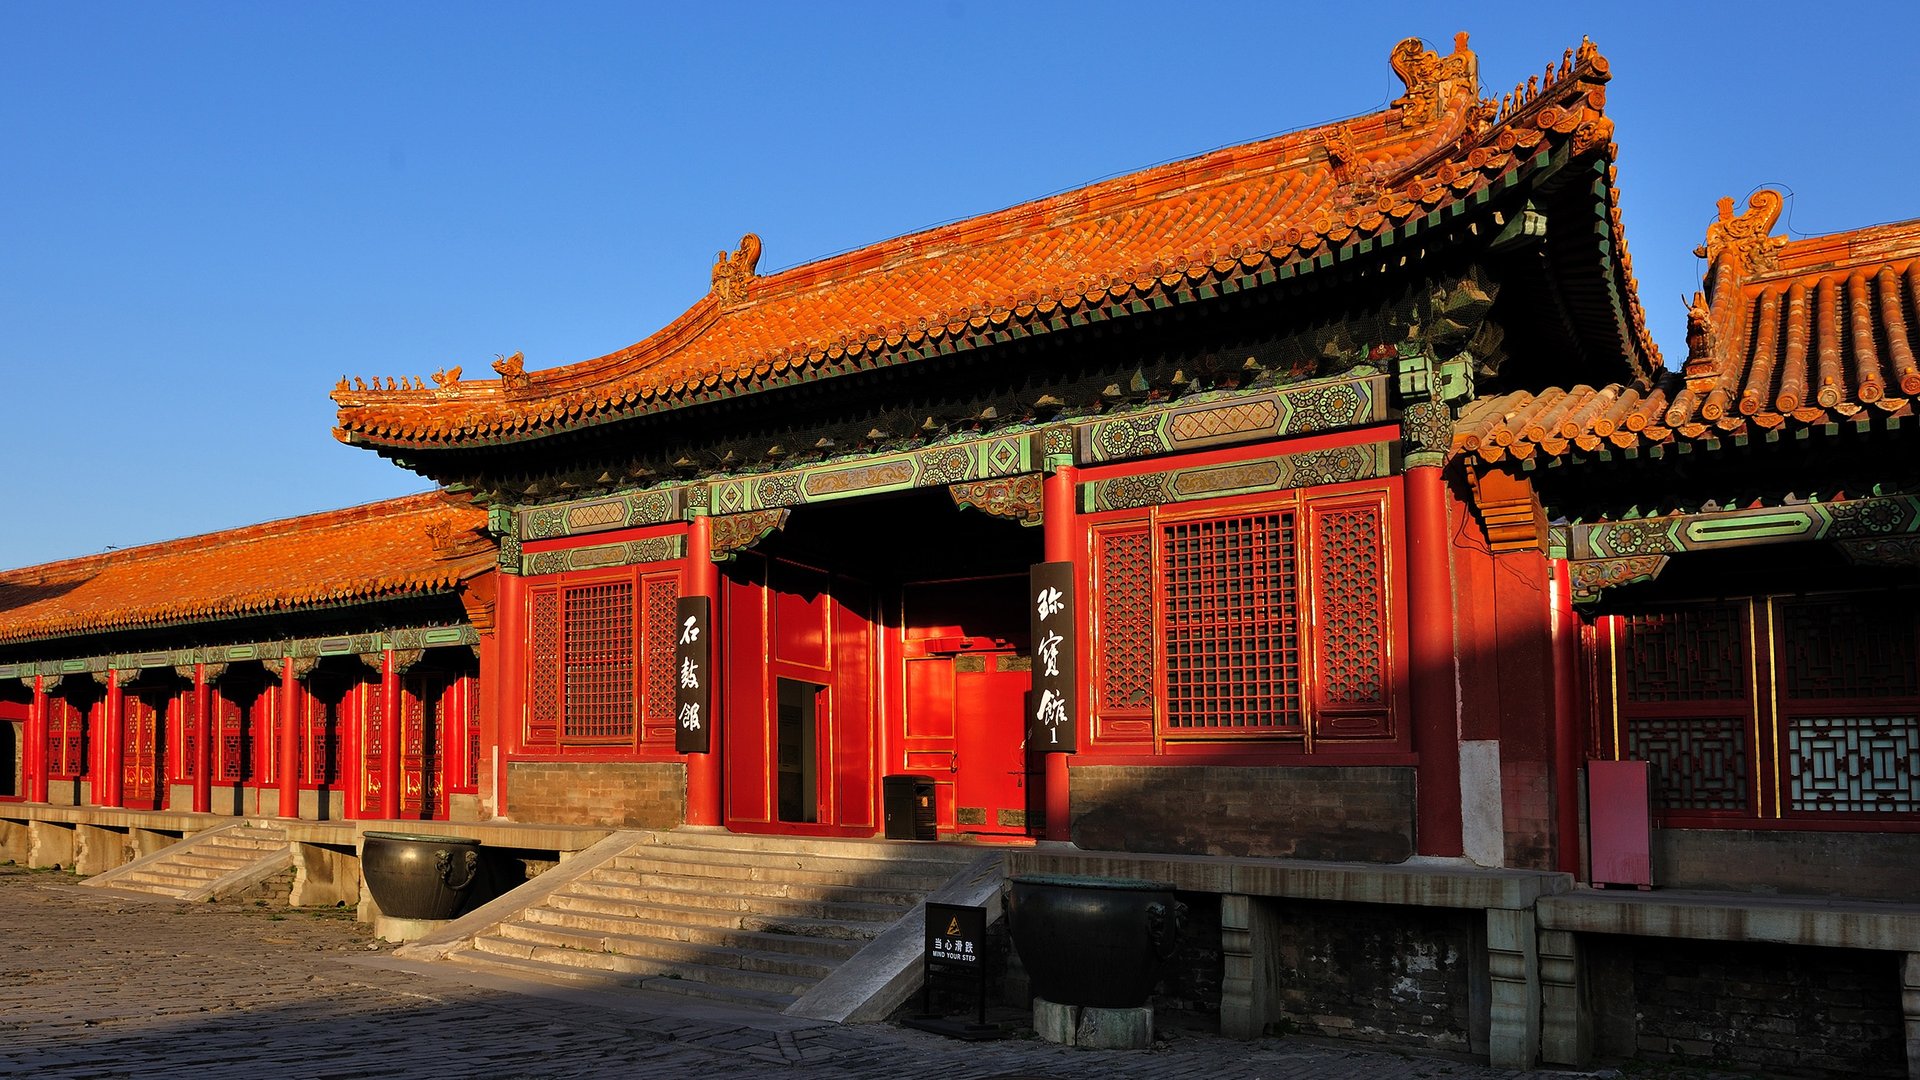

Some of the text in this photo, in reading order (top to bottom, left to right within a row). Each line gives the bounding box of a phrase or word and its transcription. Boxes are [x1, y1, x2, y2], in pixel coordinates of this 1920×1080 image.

[1050, 727, 1058, 744] 1
[934, 938, 974, 954] 当心滑跌
[932, 950, 976, 962] MIND YOUR STEP
